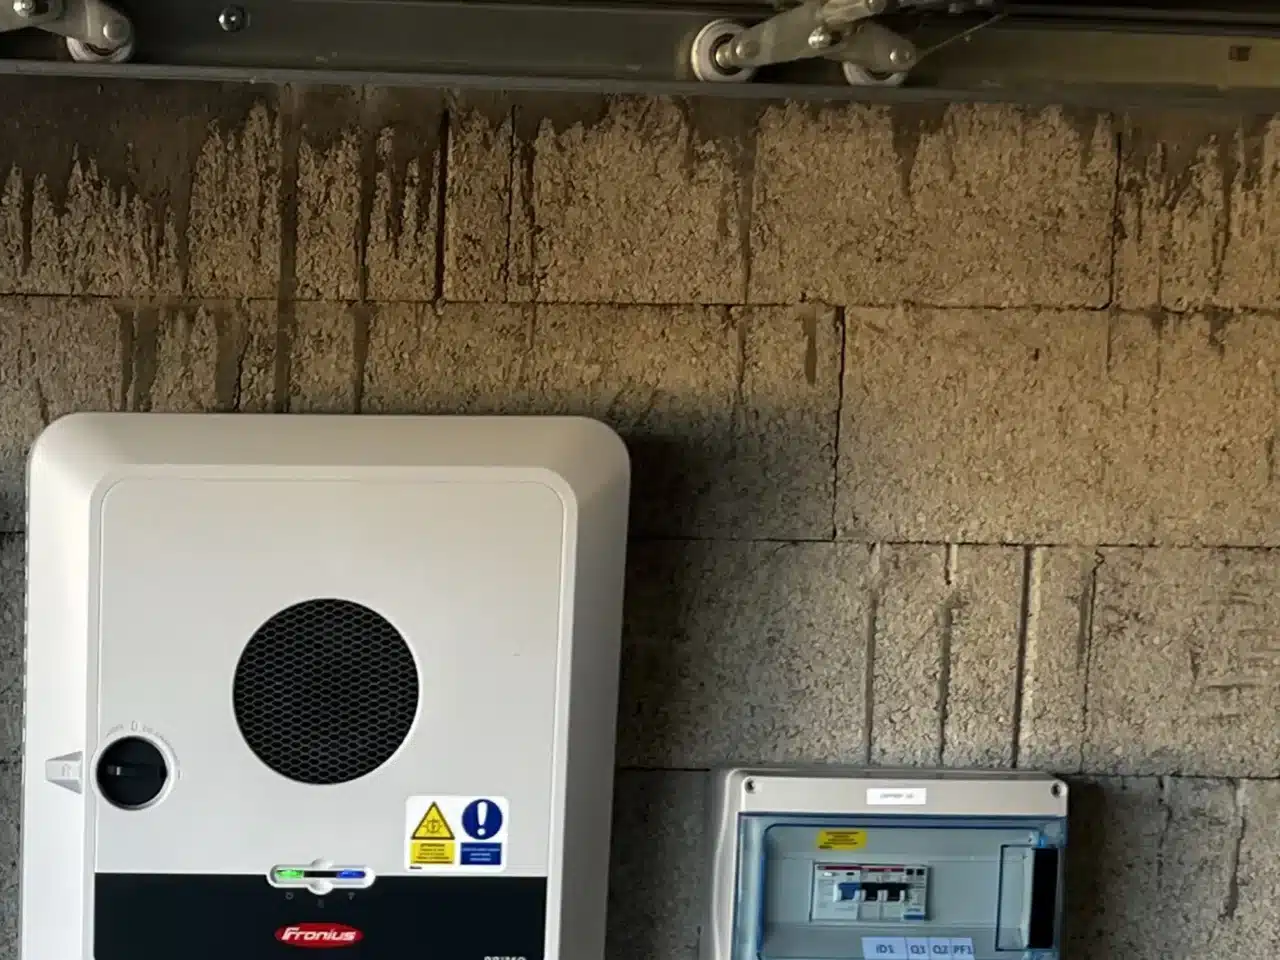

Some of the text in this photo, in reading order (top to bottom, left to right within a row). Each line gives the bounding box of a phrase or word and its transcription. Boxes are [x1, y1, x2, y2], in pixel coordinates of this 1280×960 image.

[281, 926, 357, 941] Fronius
[909, 944, 927, 955] Q1
[932, 944, 949, 955] Q2
[952, 945, 973, 955] PF1
